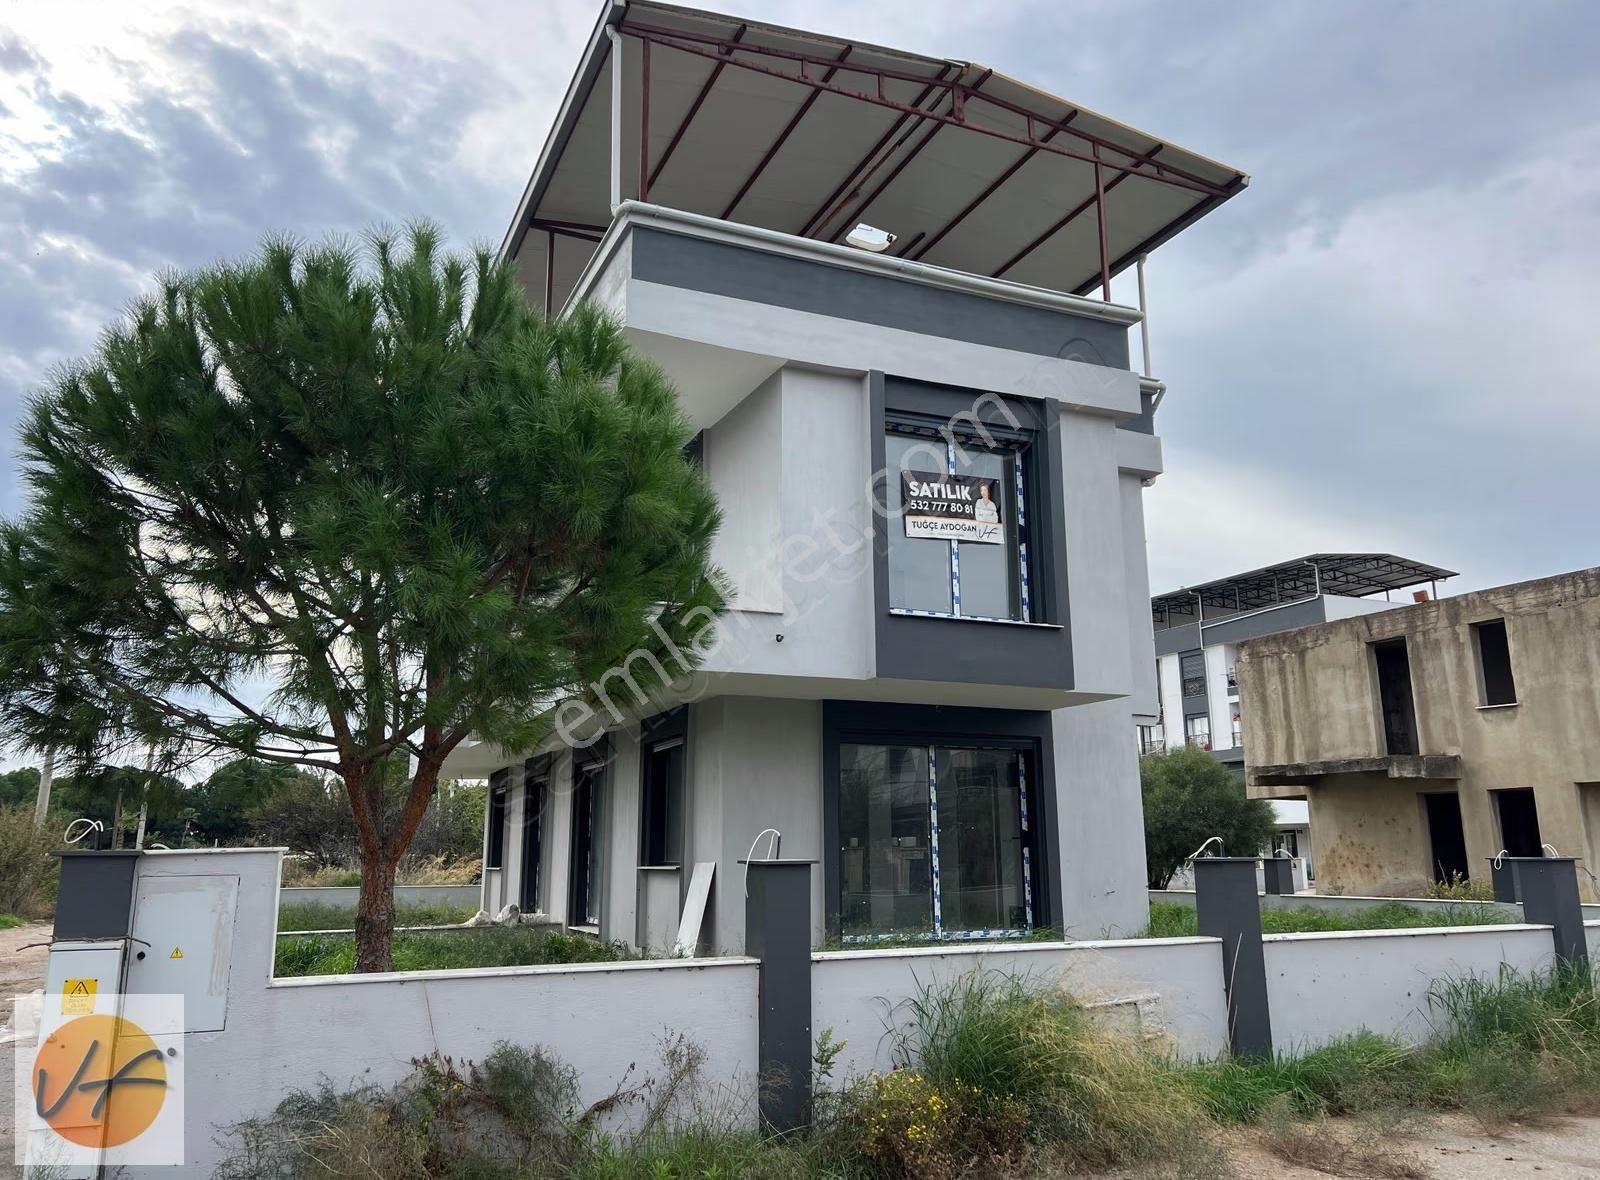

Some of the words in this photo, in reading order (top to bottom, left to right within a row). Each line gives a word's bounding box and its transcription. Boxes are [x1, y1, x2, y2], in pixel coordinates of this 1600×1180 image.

[909, 481, 972, 501] SATILIK
[910, 500, 929, 511] 532
[931, 501, 948, 512] 777
[950, 502, 963, 514] 80
[965, 504, 974, 514] 81
[911, 520, 938, 531] TUĞÇE
[940, 521, 977, 532] AYDOĞAN
